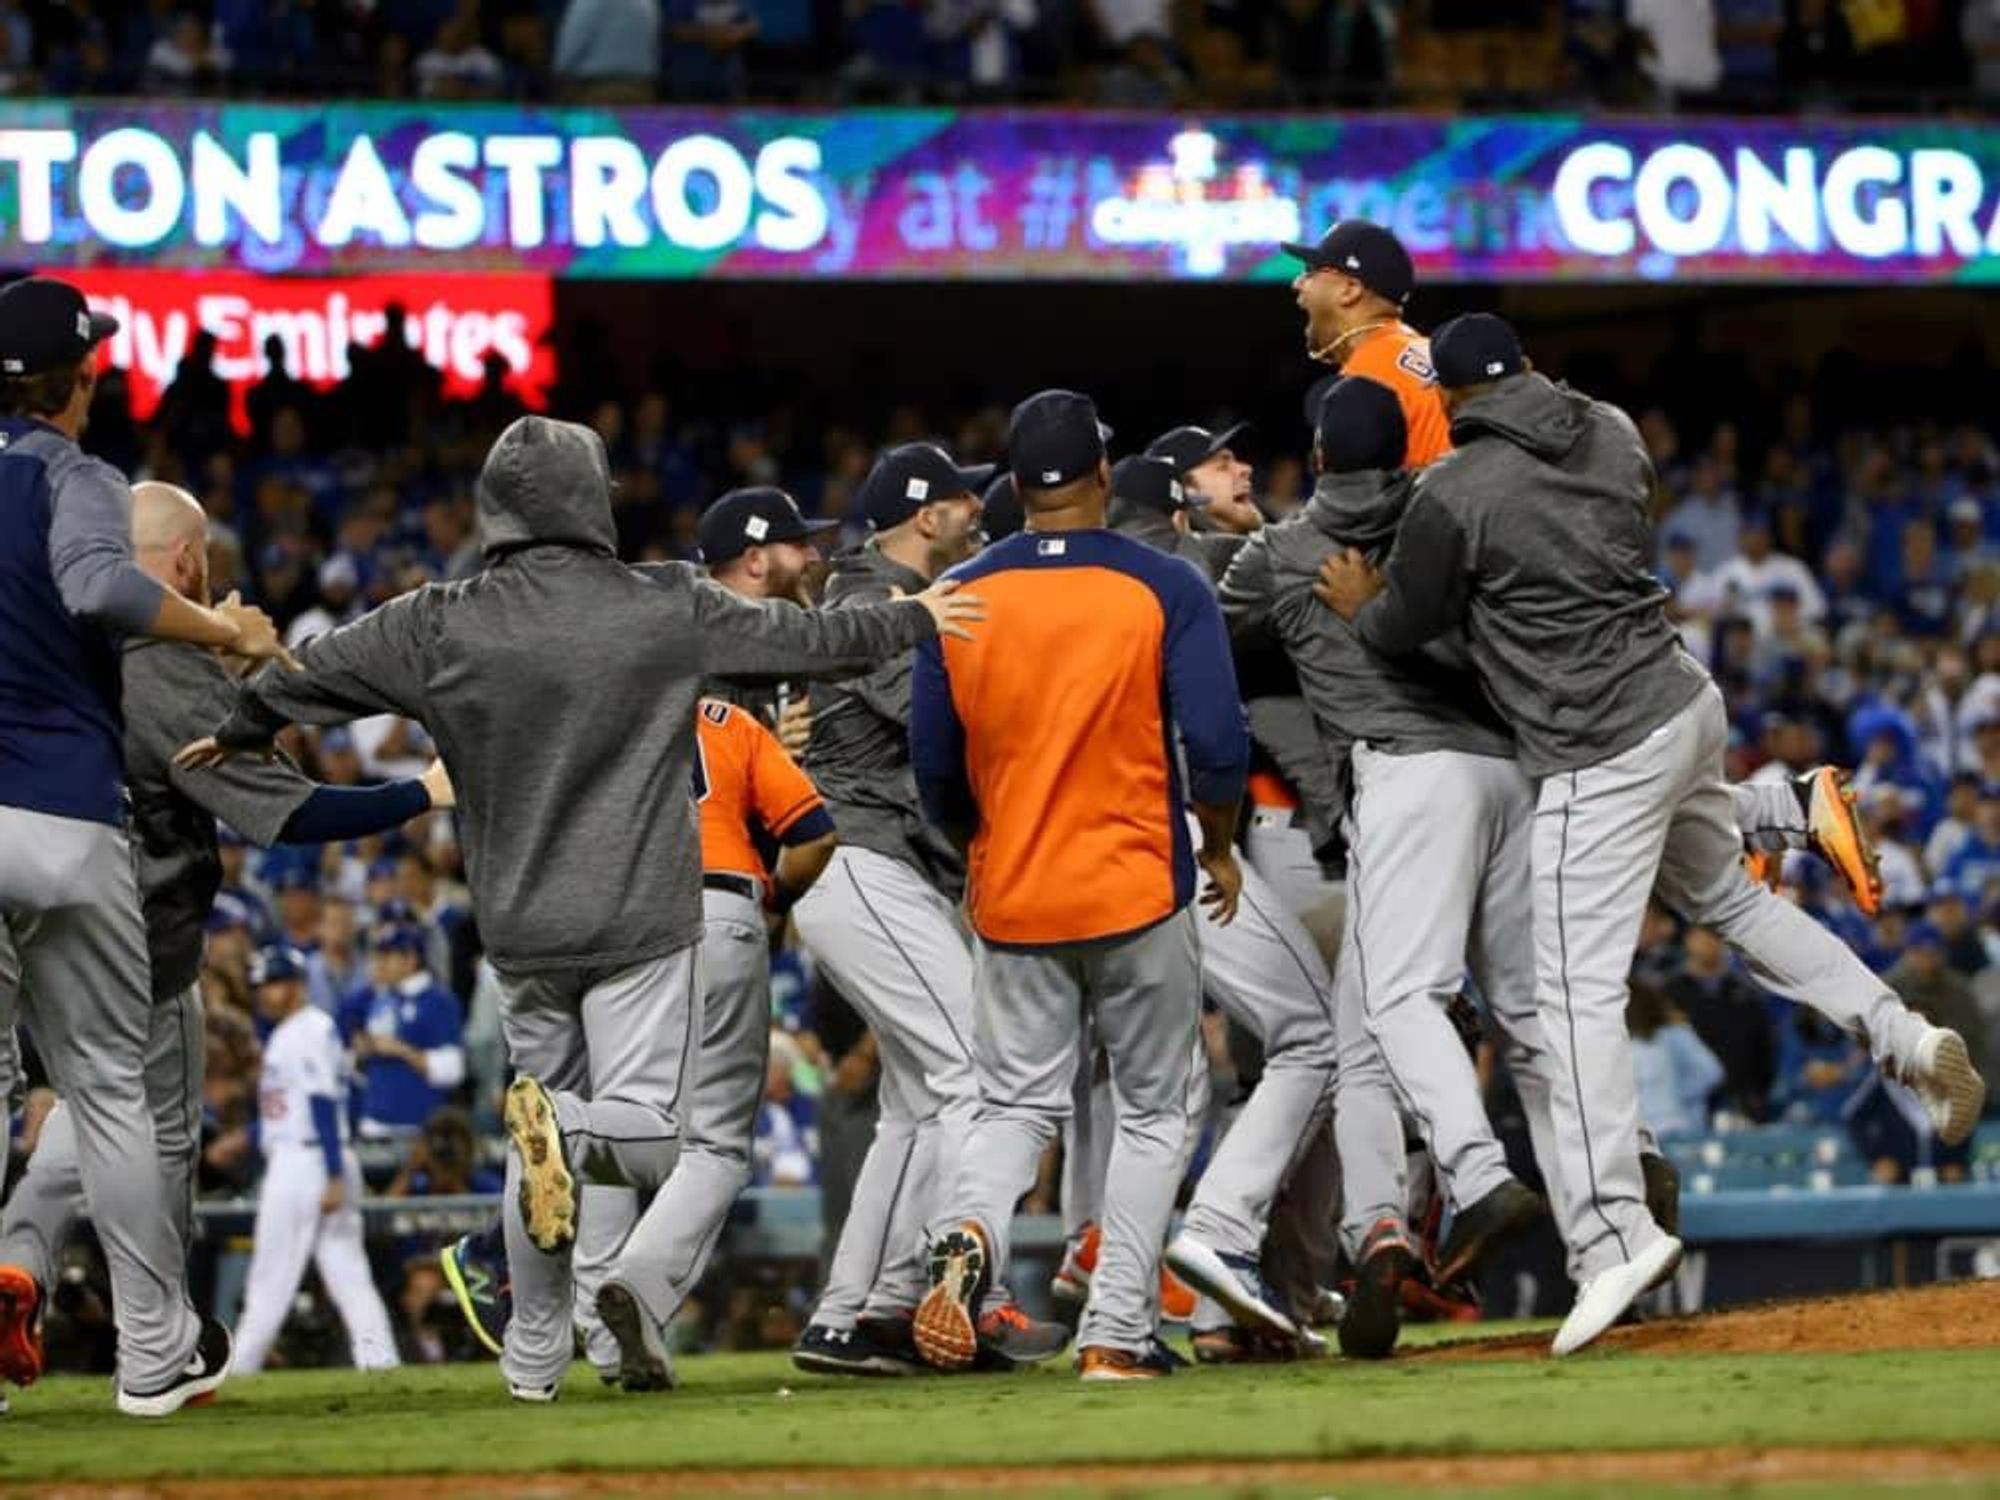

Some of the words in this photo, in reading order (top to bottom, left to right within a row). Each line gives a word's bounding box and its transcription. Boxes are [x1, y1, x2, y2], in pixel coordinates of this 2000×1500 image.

[0, 129, 283, 245] TON
[316, 133, 828, 251] ASTROS
[1552, 143, 2000, 256] CONGR
